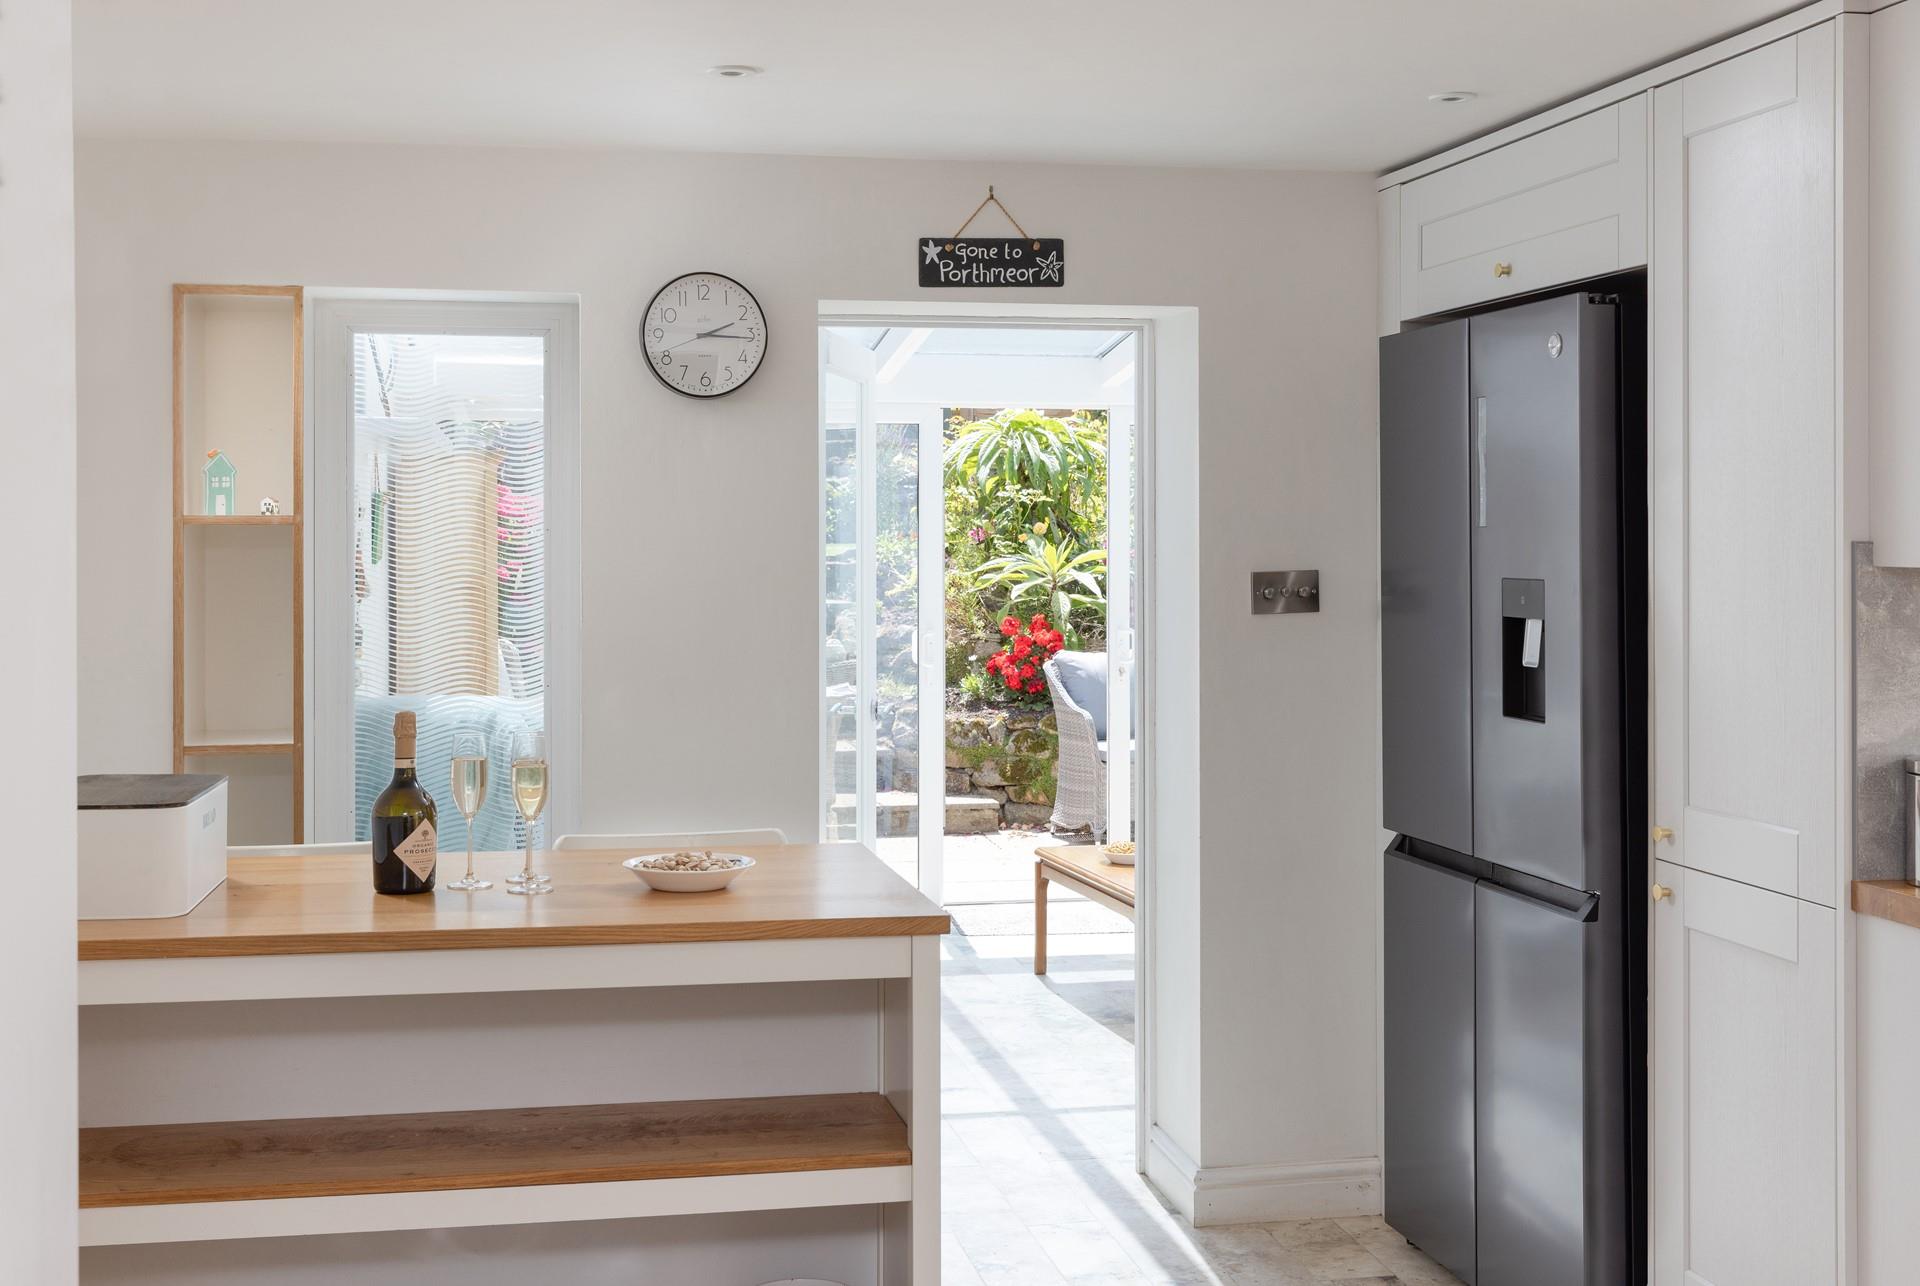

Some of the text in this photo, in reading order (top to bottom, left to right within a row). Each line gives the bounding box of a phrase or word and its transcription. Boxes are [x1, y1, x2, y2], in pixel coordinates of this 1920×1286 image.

[955, 242, 1022, 264] Gone to
[939, 259, 1040, 284] Porthmeor
[678, 290, 687, 307] 11
[697, 284, 710, 301] 12
[660, 307, 677, 324] 10
[738, 304, 748, 321] 2
[653, 327, 664, 343] 9
[747, 327, 755, 343] 3
[661, 349, 672, 365] 8
[737, 349, 748, 364] 4
[679, 364, 688, 381] 7
[700, 371, 711, 387] 6
[724, 366, 733, 381] 5
